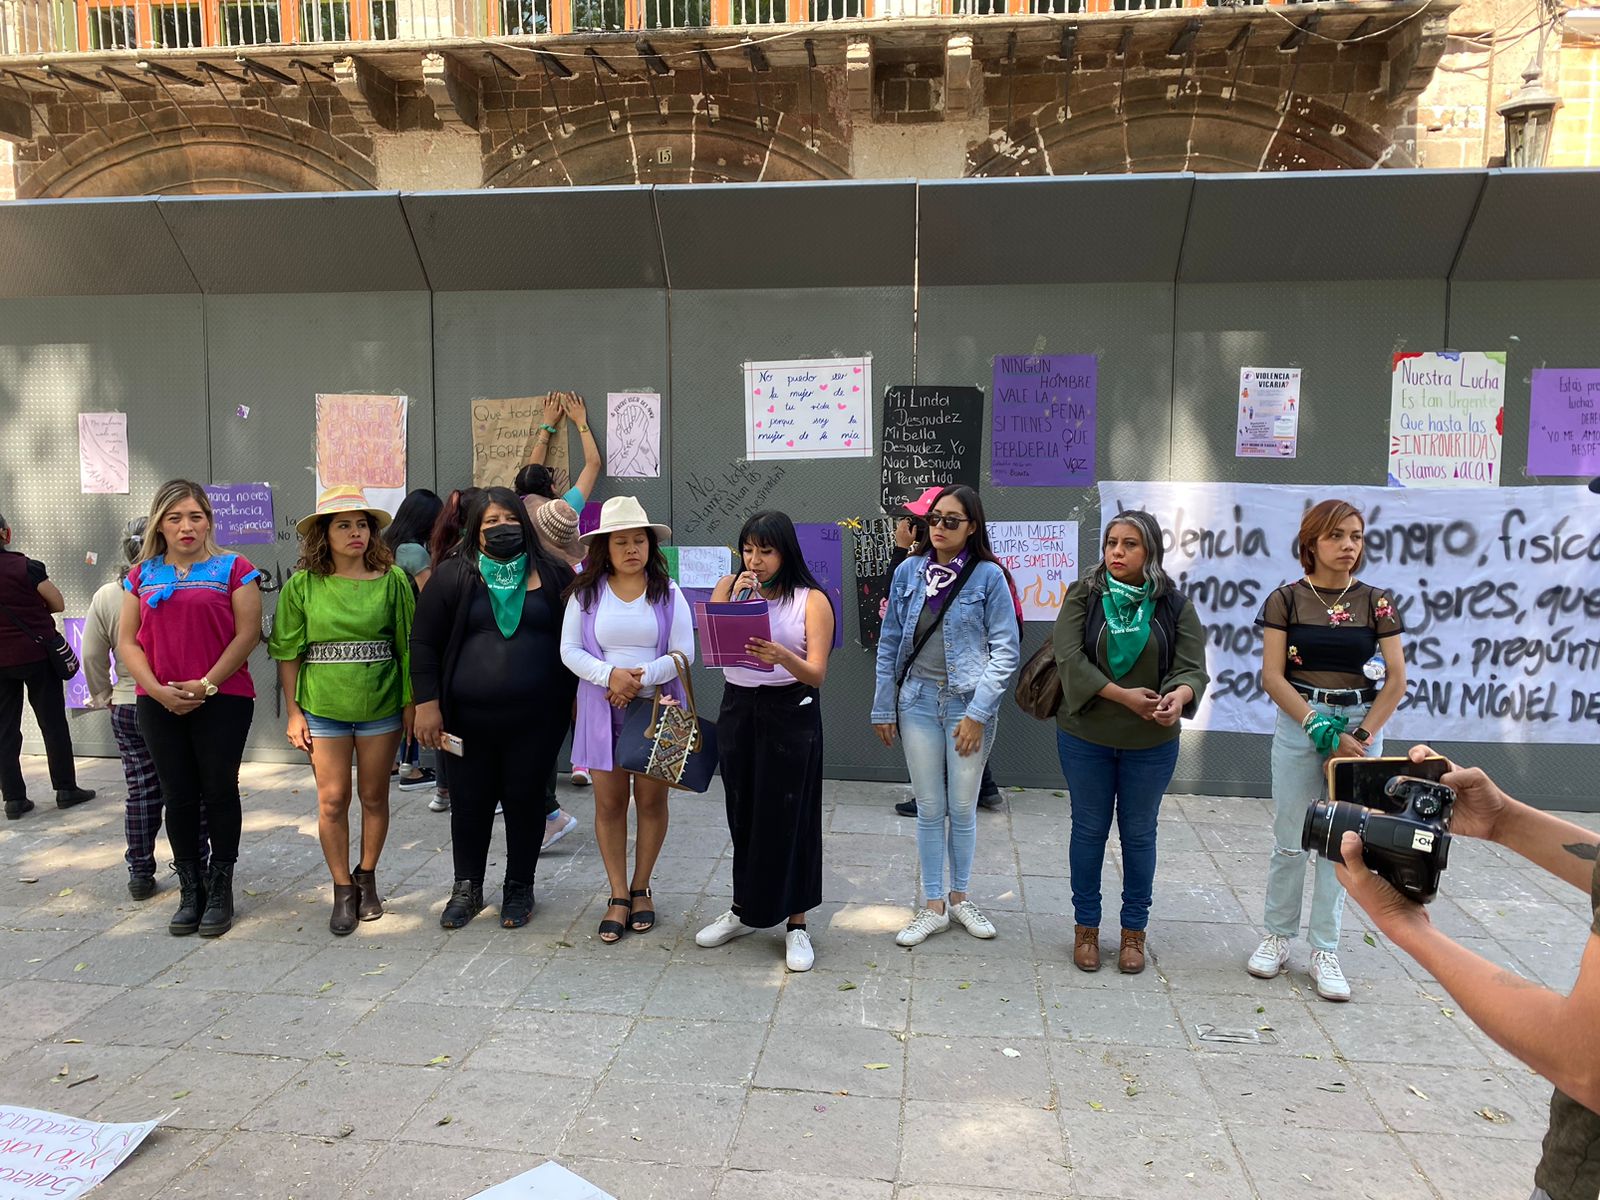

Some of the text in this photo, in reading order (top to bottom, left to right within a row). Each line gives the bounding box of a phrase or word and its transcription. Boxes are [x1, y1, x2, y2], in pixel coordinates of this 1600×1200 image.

[660, 150, 670, 160] 15
[1256, 372, 1290, 380] VIOLENCIA
[1402, 358, 1499, 390] Nuestra Lucha
[790, 389, 813, 401] mujer
[889, 388, 950, 407] Mi Linda
[999, 388, 1049, 403] VALE LA
[1402, 387, 1497, 416] Es tan Urgente
[1568, 396, 1594, 409] luchas
[474, 405, 502, 421] Que
[785, 403, 795, 411] tu
[1051, 403, 1086, 419] PENA
[768, 418, 794, 428] porque
[894, 409, 962, 427] Desnudez
[994, 416, 1006, 432] SI
[1401, 412, 1486, 434] Que hasta las
[758, 431, 784, 443] mujer
[885, 426, 936, 441] Mi bella
[1564, 431, 1574, 440] ME
[950, 439, 966, 455] Yo
[1400, 432, 1497, 460] INTROVERTIDAS
[913, 455, 960, 470] Desnuda
[1063, 458, 1088, 474] VOZ
[1398, 459, 1447, 480] Estamos
[882, 469, 953, 485] El Pervertido
[685, 472, 716, 502] No
[236, 492, 250, 502] no
[882, 487, 910, 506] Eres
[228, 520, 273, 535] inspiración
[1001, 525, 1022, 537] UNA
[1028, 525, 1065, 538] MUJER
[277, 531, 291, 541] NO
[1024, 552, 1075, 568] SOMETIDAS
[1047, 569, 1062, 581] 8M
[1396, 678, 1453, 717] SAN
